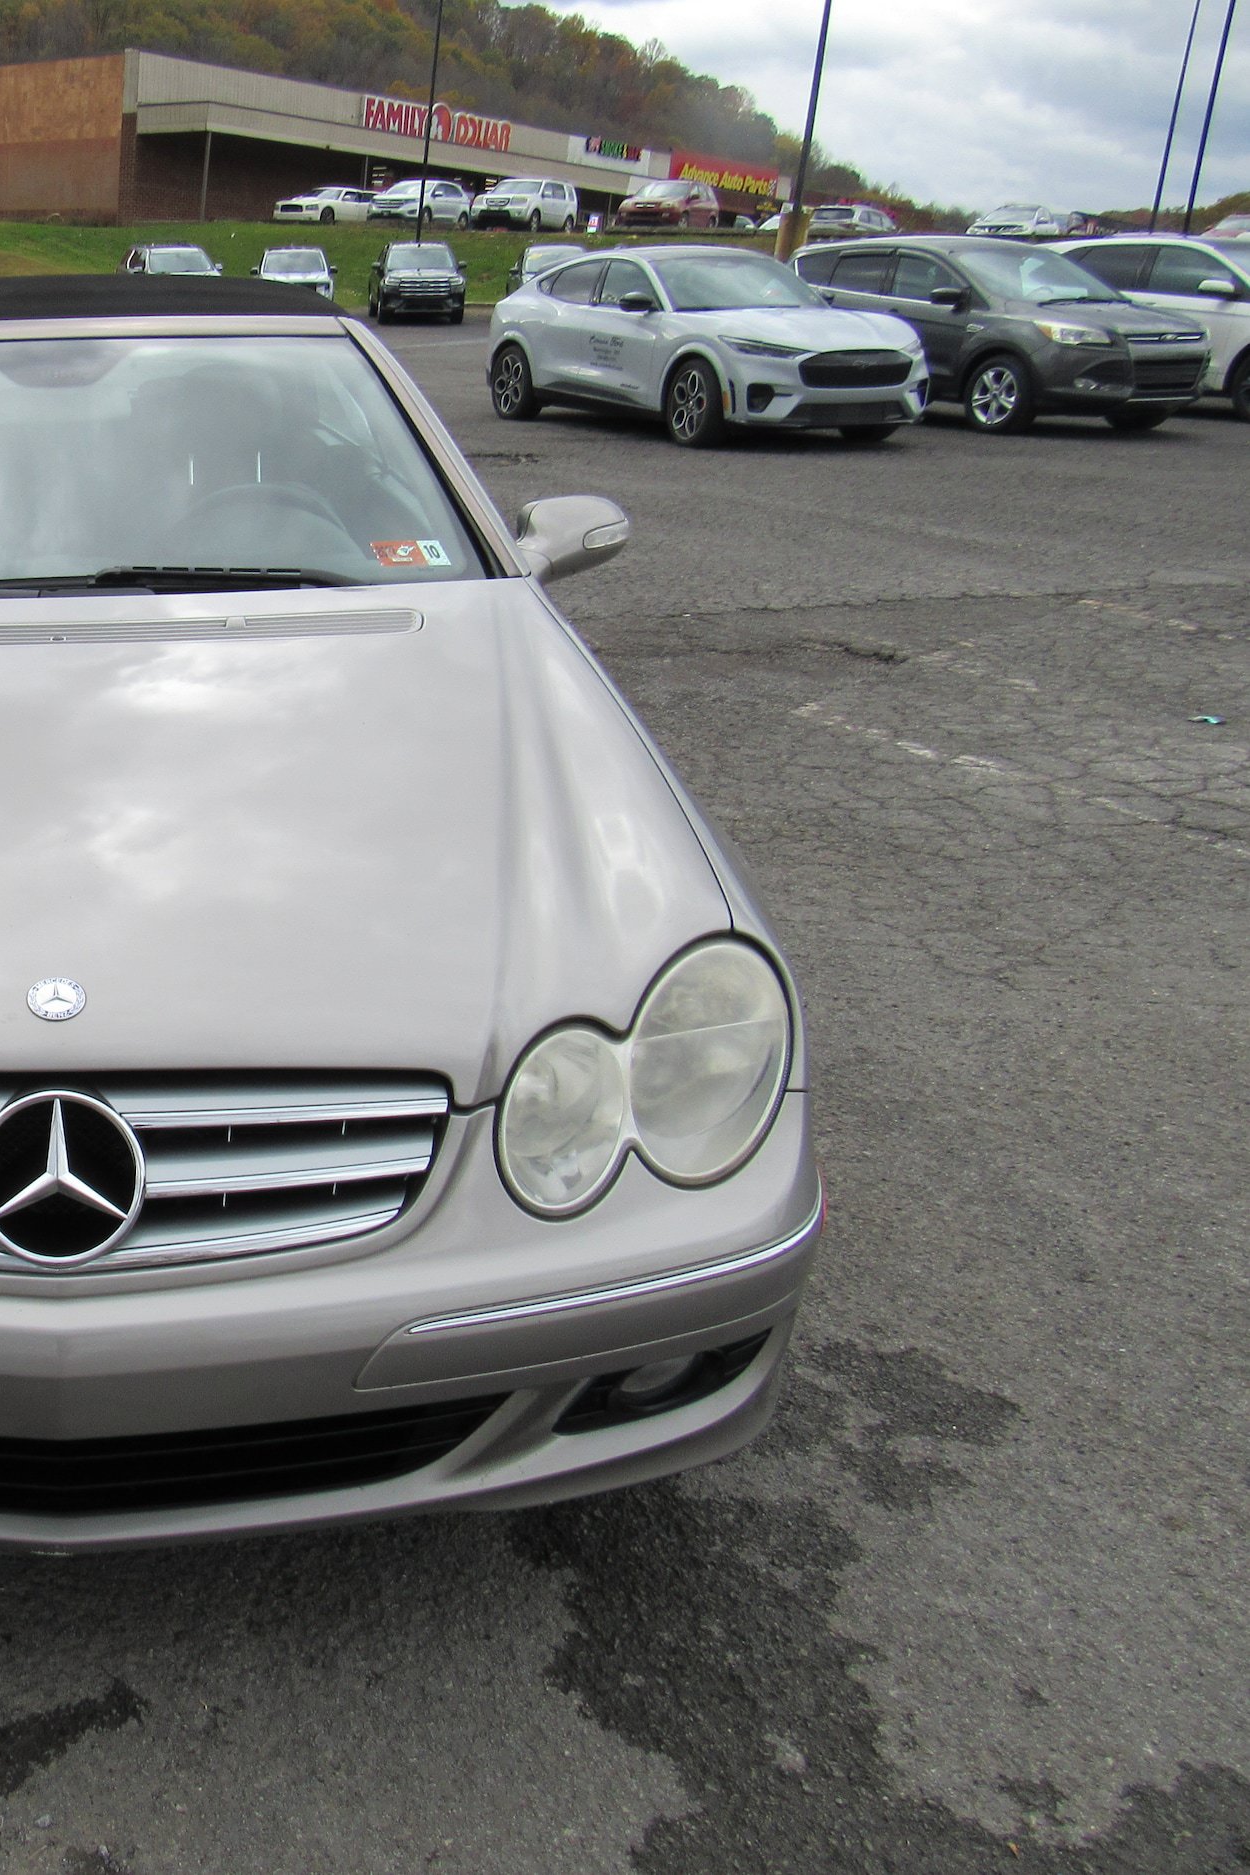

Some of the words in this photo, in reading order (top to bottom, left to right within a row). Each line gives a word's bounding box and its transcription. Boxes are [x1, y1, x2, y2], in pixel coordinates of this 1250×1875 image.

[364, 97, 430, 139] FAMILY
[453, 113, 512, 152] DOLLAR
[679, 162, 720, 187] Advance
[718, 171, 744, 191] Auto
[743, 175, 769, 196] Parts
[423, 545, 440, 559] 10
